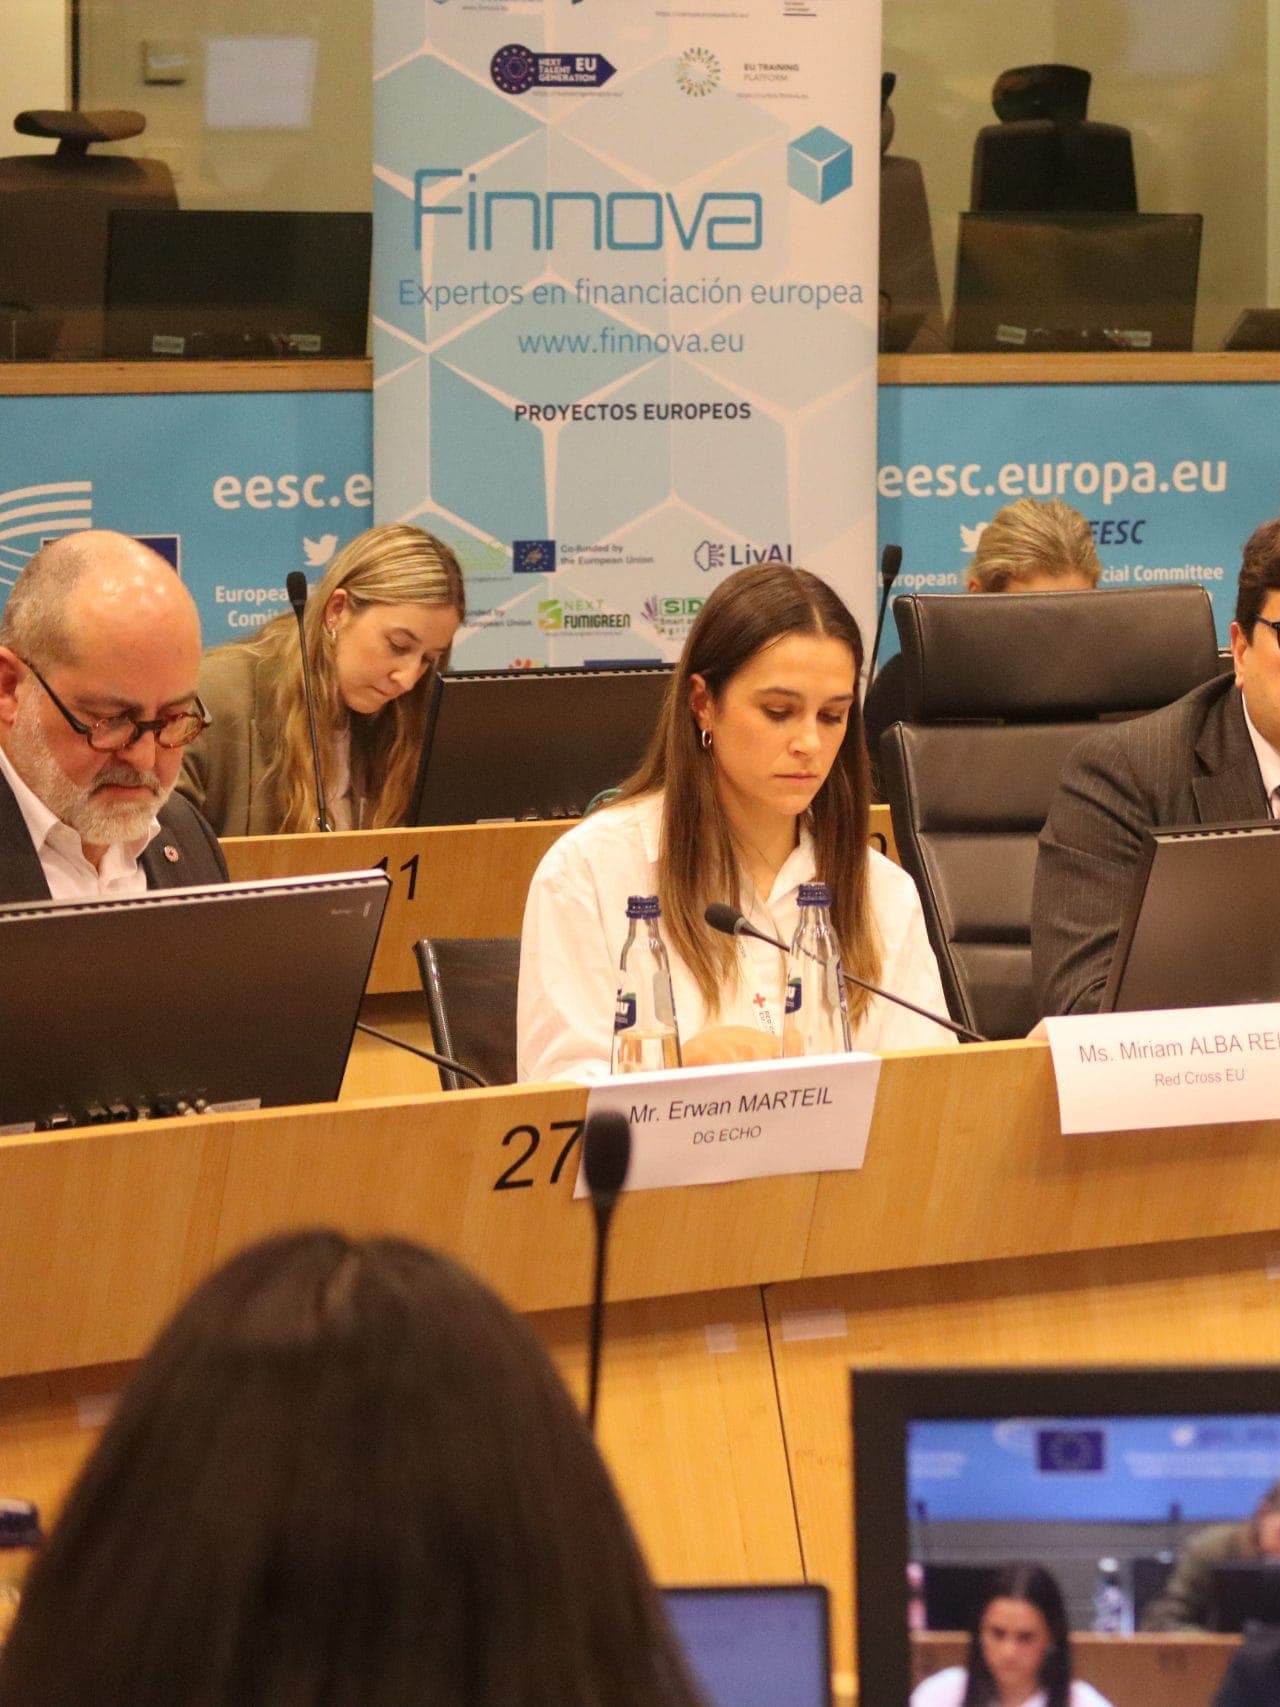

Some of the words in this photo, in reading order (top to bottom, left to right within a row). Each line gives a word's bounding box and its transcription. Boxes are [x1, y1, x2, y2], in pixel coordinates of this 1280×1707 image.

[538, 58, 561, 66] NEXT
[539, 66, 571, 74] TALENT
[575, 57, 597, 72] EU
[759, 63, 799, 72] TRAINING
[538, 74, 597, 82] GENERATION
[414, 168, 763, 251] Finnova
[399, 279, 524, 311] Expertos
[531, 284, 566, 305] en
[574, 274, 741, 305] financiación
[750, 281, 863, 309] europea
[517, 328, 744, 354] www.finnova.eu
[514, 403, 637, 421] PROYECTOS
[643, 402, 751, 420] EUROPEOS
[878, 460, 1227, 505] eesc.europa.eu
[560, 543, 609, 554] Co-funded
[611, 544, 624, 555] by
[730, 543, 792, 565] LivAI
[578, 555, 624, 566] European
[626, 554, 654, 564] Union
[1134, 563, 1224, 581] Committee
[564, 601, 604, 610] NEXT
[564, 614, 631, 628] FUMIGREEN
[1079, 1044, 1113, 1063] Ms.
[1120, 1039, 1183, 1061] Miriam
[1189, 1034, 1242, 1056] ALBA
[1154, 1072, 1181, 1087] Red
[1184, 1069, 1222, 1085] Cross
[1226, 1067, 1245, 1082] EU
[629, 1103, 660, 1123] Mr.
[668, 1100, 731, 1121] Erwan
[737, 1086, 833, 1114] MARTEIL
[692, 1130, 715, 1145] DG
[718, 1125, 762, 1142] ECHO
[493, 1119, 586, 1191] 27
